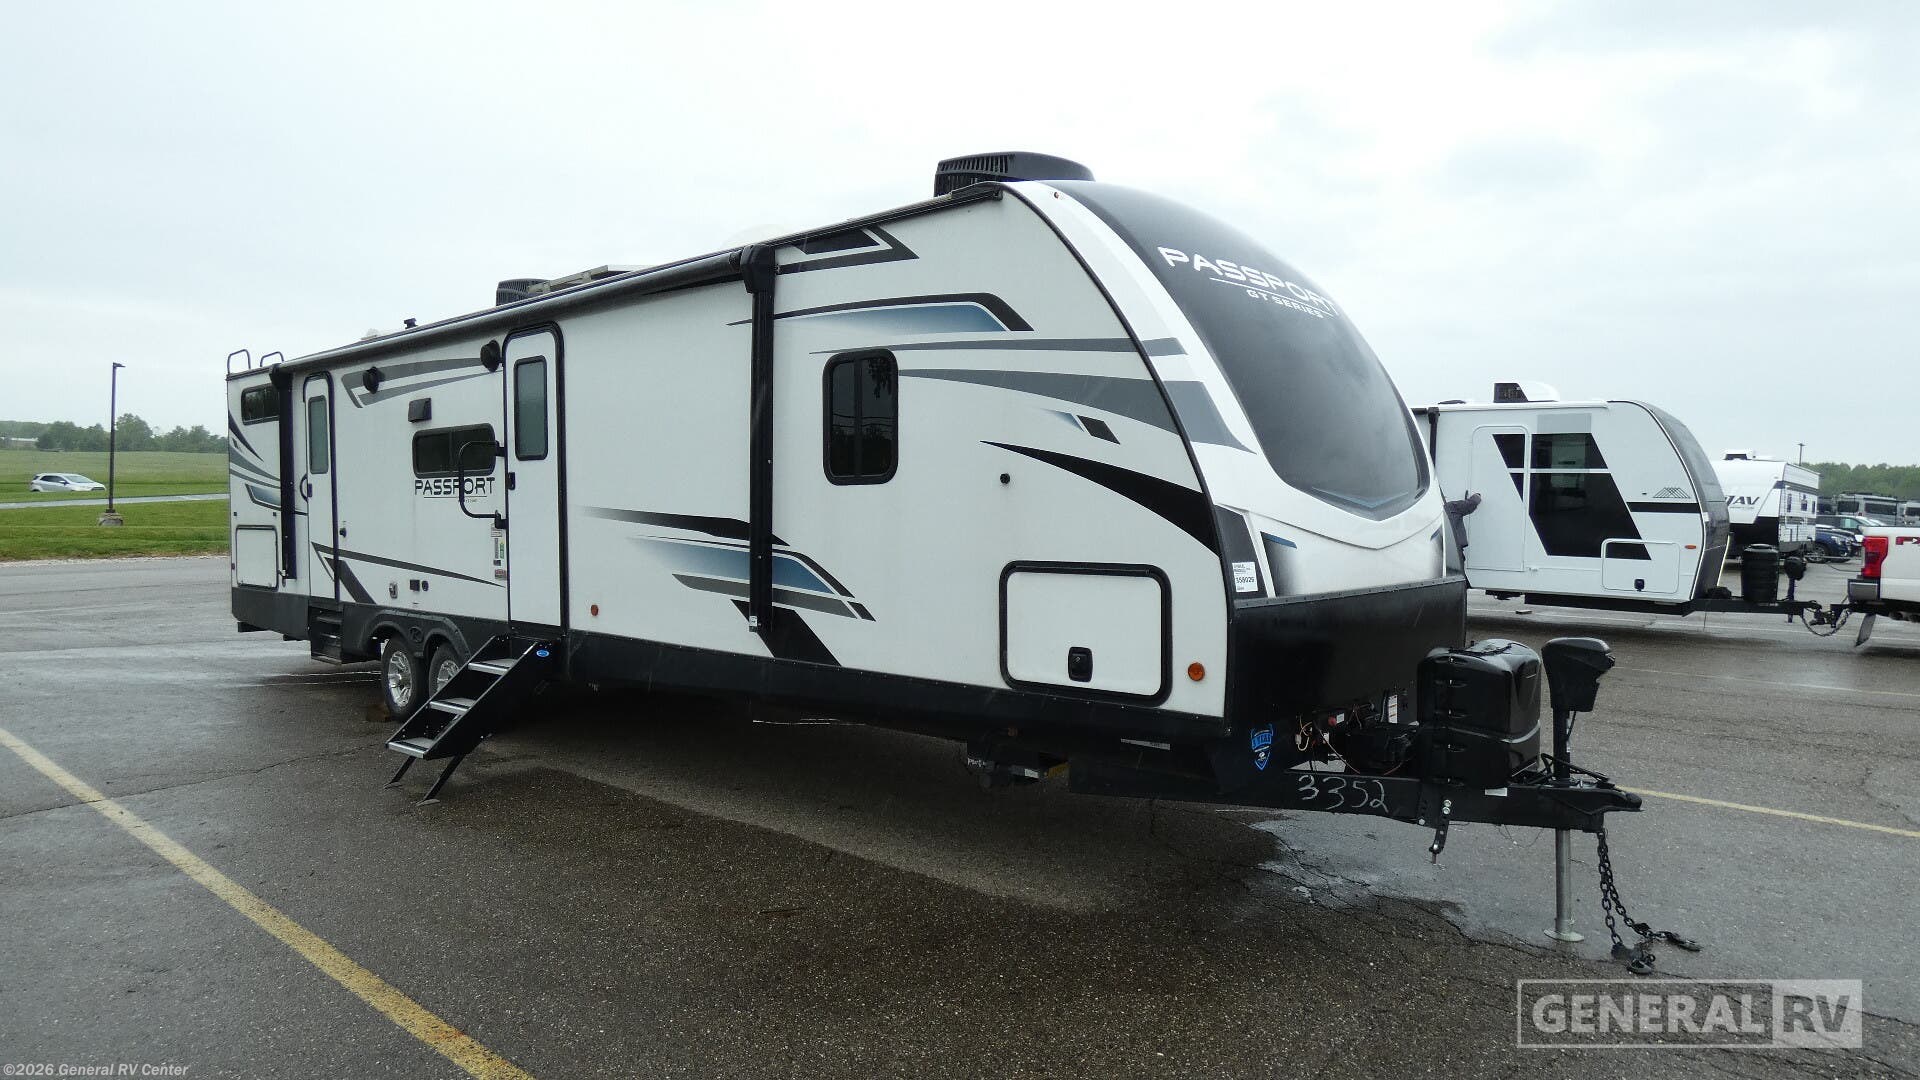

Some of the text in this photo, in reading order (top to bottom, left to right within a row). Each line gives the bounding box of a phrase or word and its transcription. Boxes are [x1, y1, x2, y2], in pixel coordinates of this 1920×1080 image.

[1157, 246, 1339, 316] PASSPORT
[1246, 289, 1324, 319] GT SERIES
[415, 477, 496, 495] PASSPORT
[1298, 774, 1389, 813] 3352
